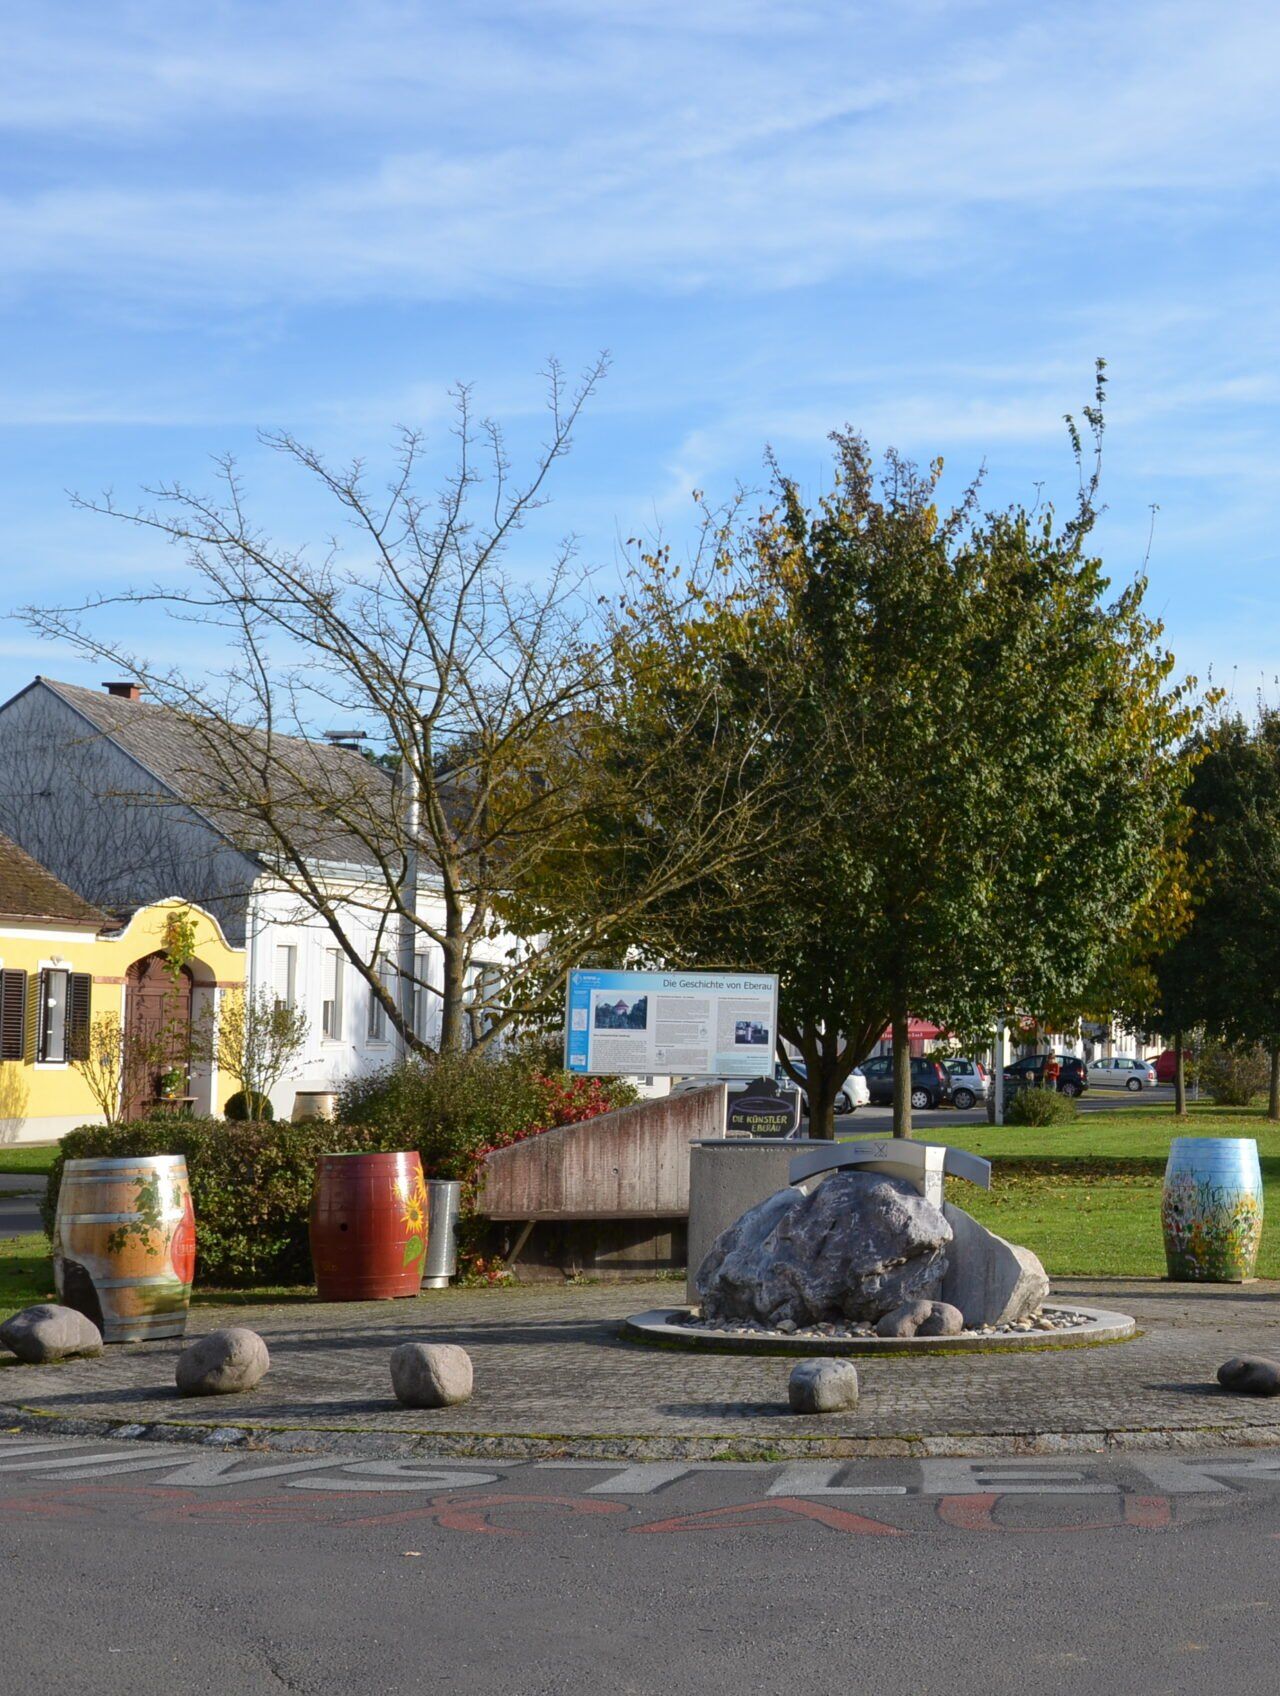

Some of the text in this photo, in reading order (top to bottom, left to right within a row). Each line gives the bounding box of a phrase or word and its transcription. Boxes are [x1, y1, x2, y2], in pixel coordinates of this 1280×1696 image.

[663, 979, 678, 988] Die
[679, 979, 723, 989] Geschichte
[744, 980, 772, 991] Eberau
[732, 1114, 788, 1124] DIE KÜNSTLER
[751, 1124, 781, 1132] EBERAU
